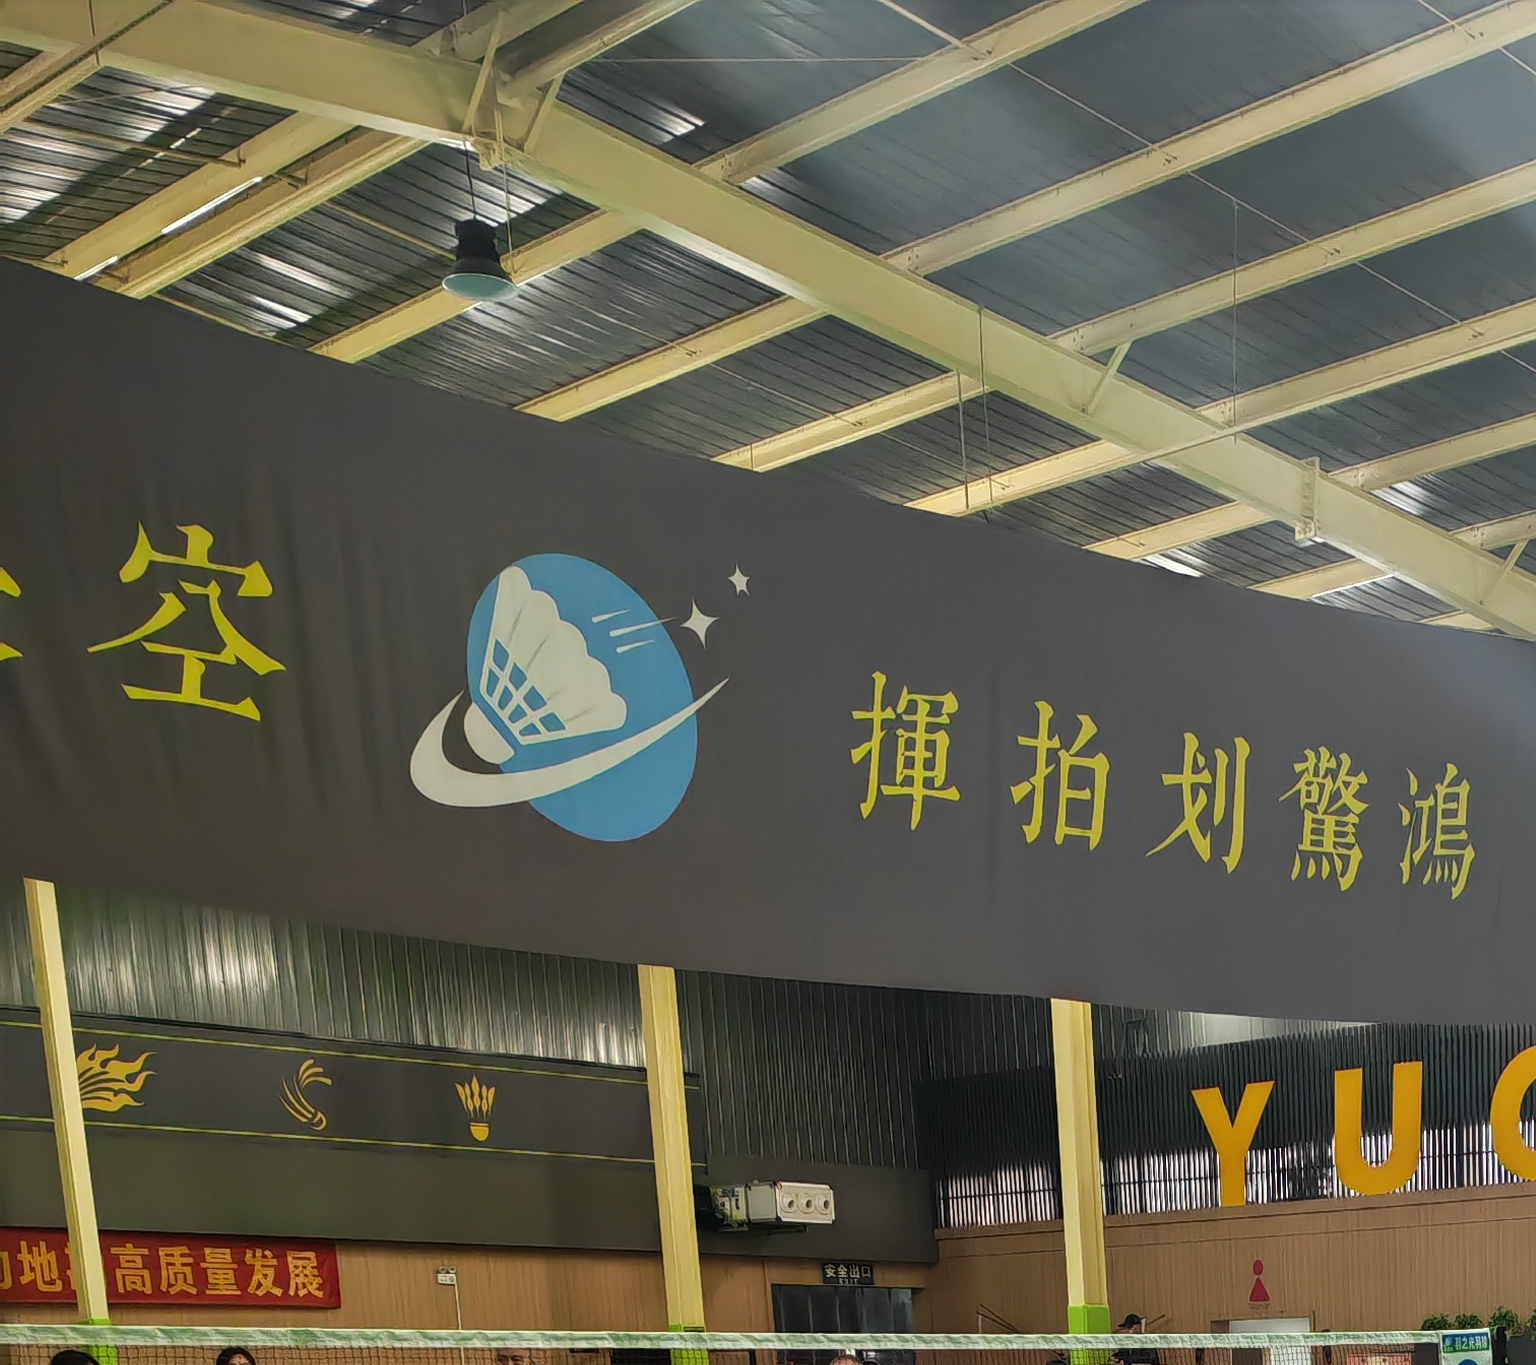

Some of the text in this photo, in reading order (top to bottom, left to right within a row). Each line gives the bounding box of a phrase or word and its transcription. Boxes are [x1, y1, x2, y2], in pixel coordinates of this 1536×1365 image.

[0, 521, 1475, 899] 空 揮拍划驚鴻
[0, 1240, 323, 1299] 地高质量发展
[824, 1263, 871, 1278] 安全出口
